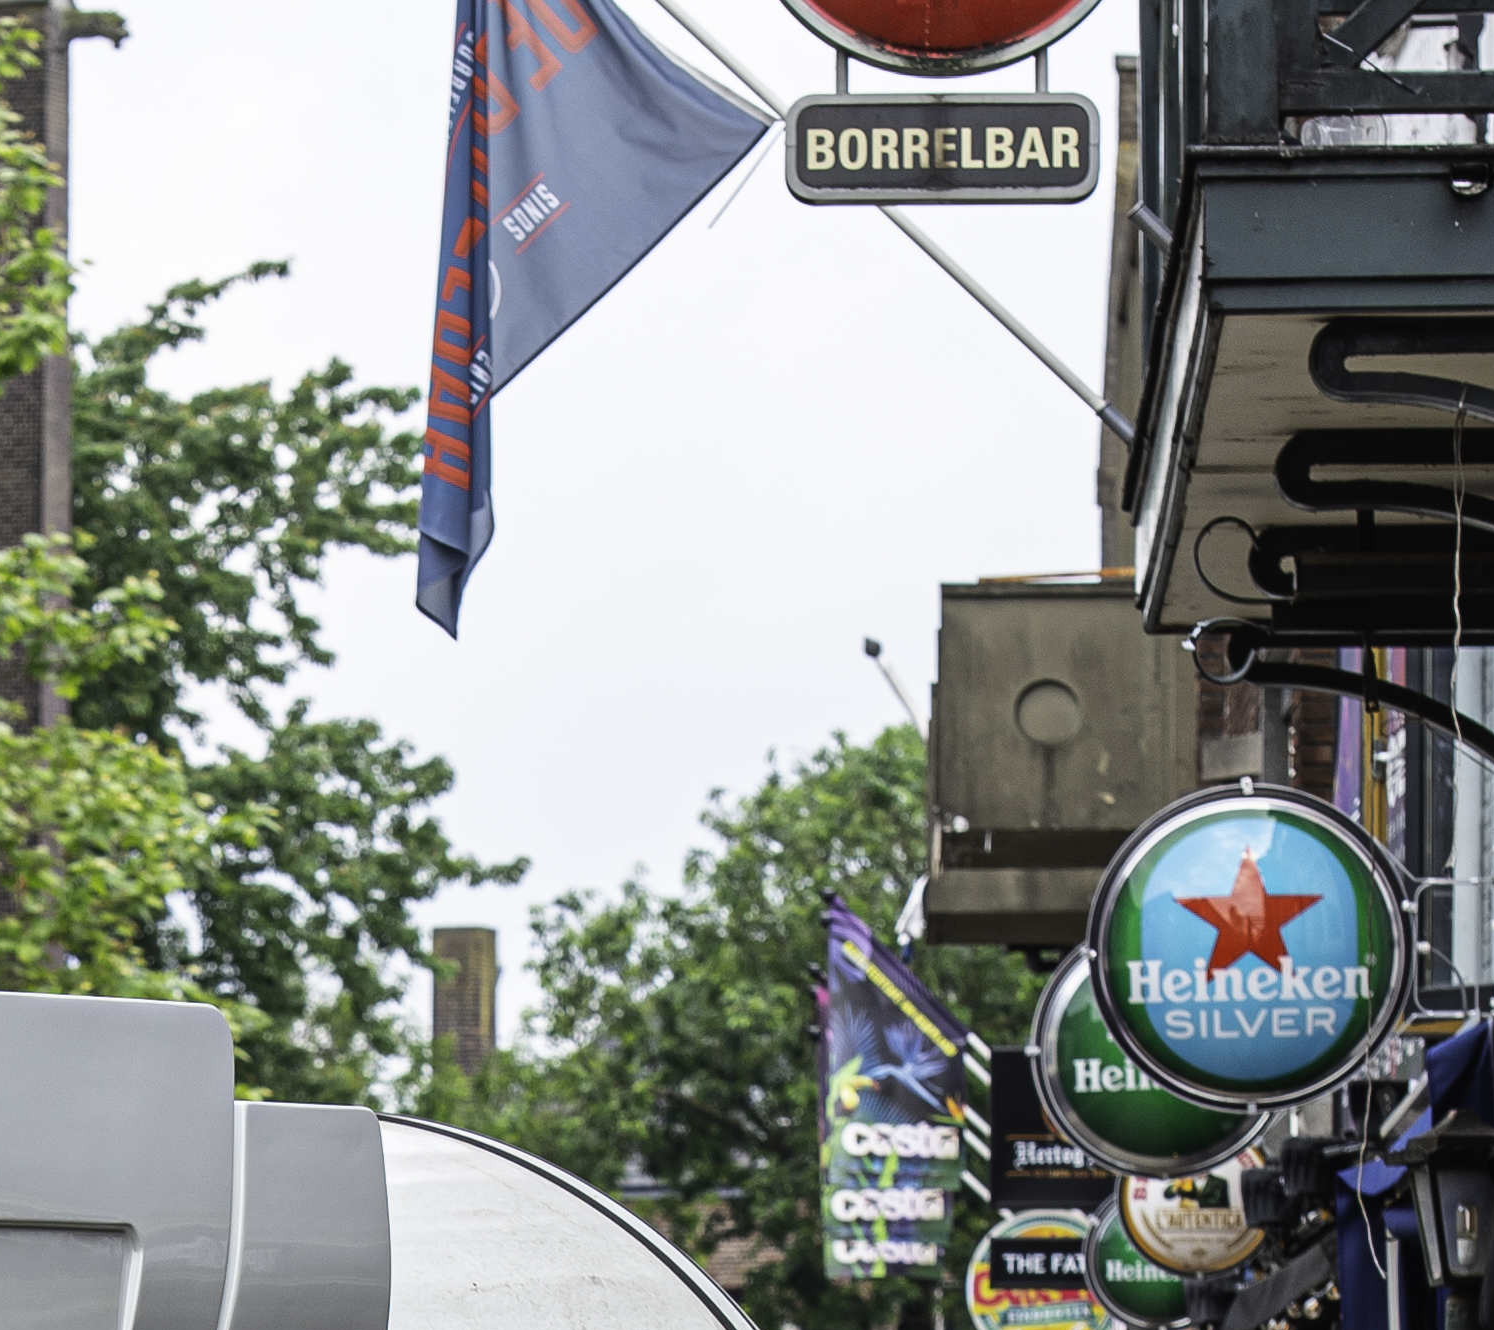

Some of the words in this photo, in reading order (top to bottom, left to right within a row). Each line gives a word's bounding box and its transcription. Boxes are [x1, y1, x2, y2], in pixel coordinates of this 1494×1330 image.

[806, 127, 1081, 171] BORRELBAR
[1127, 957, 1372, 1004] Heineken
[1166, 1007, 1337, 1040] SILVER
[1002, 1253, 1047, 1274] THE
